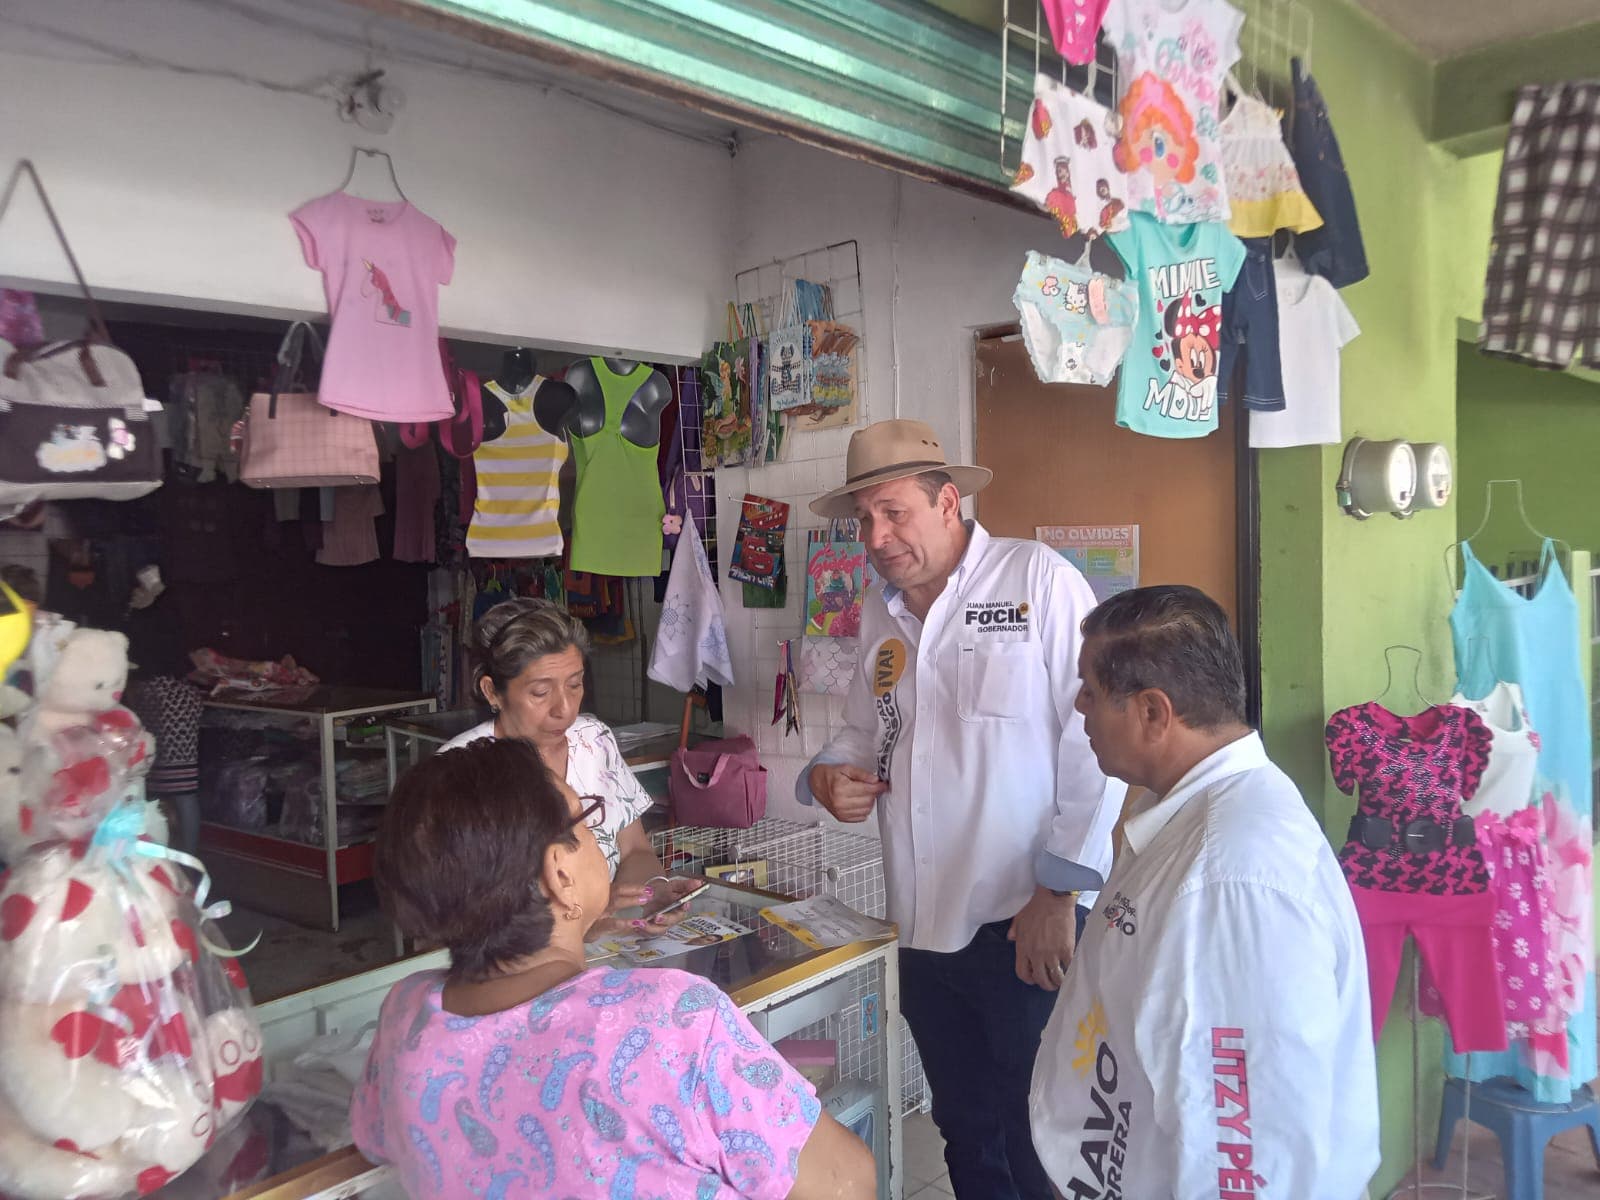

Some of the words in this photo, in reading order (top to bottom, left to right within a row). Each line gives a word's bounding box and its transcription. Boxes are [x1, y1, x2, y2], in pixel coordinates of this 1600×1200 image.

[1046, 528, 1065, 541] NO
[1069, 527, 1130, 541] OLVIDES
[986, 600, 1014, 609] MANUEL
[977, 624, 1029, 633] GOBERNADOR
[1211, 1027, 1252, 1140] LITZY
